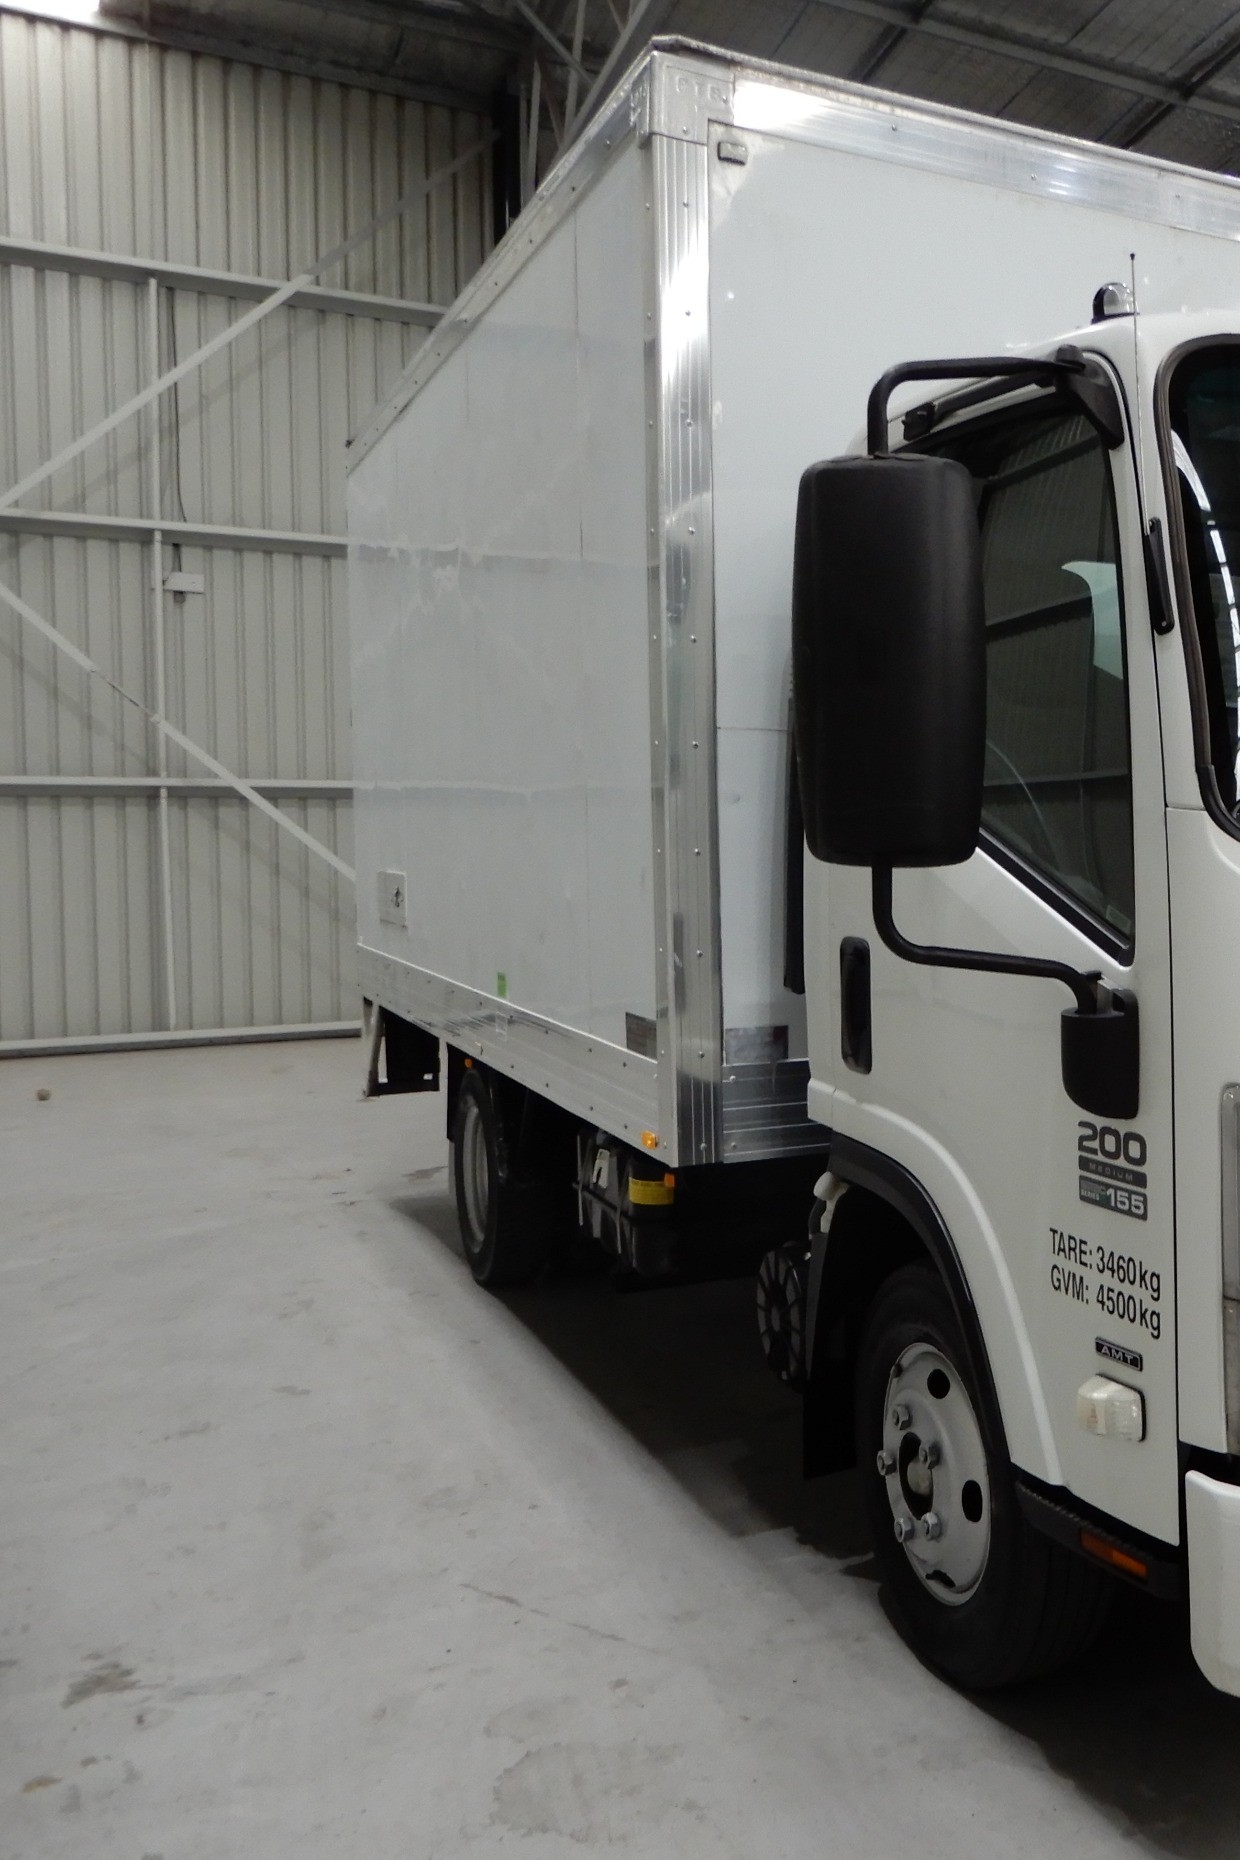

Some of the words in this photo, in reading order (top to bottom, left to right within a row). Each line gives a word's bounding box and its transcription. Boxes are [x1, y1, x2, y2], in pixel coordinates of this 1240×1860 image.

[1077, 1120, 1147, 1167] 200
[1089, 1162, 1134, 1181] MEDIUM
[1106, 1187, 1145, 1216] 155
[1049, 1227, 1093, 1270] TARE:
[1050, 1264, 1090, 1305] GVM:
[1100, 1345, 1134, 1366] AMT
